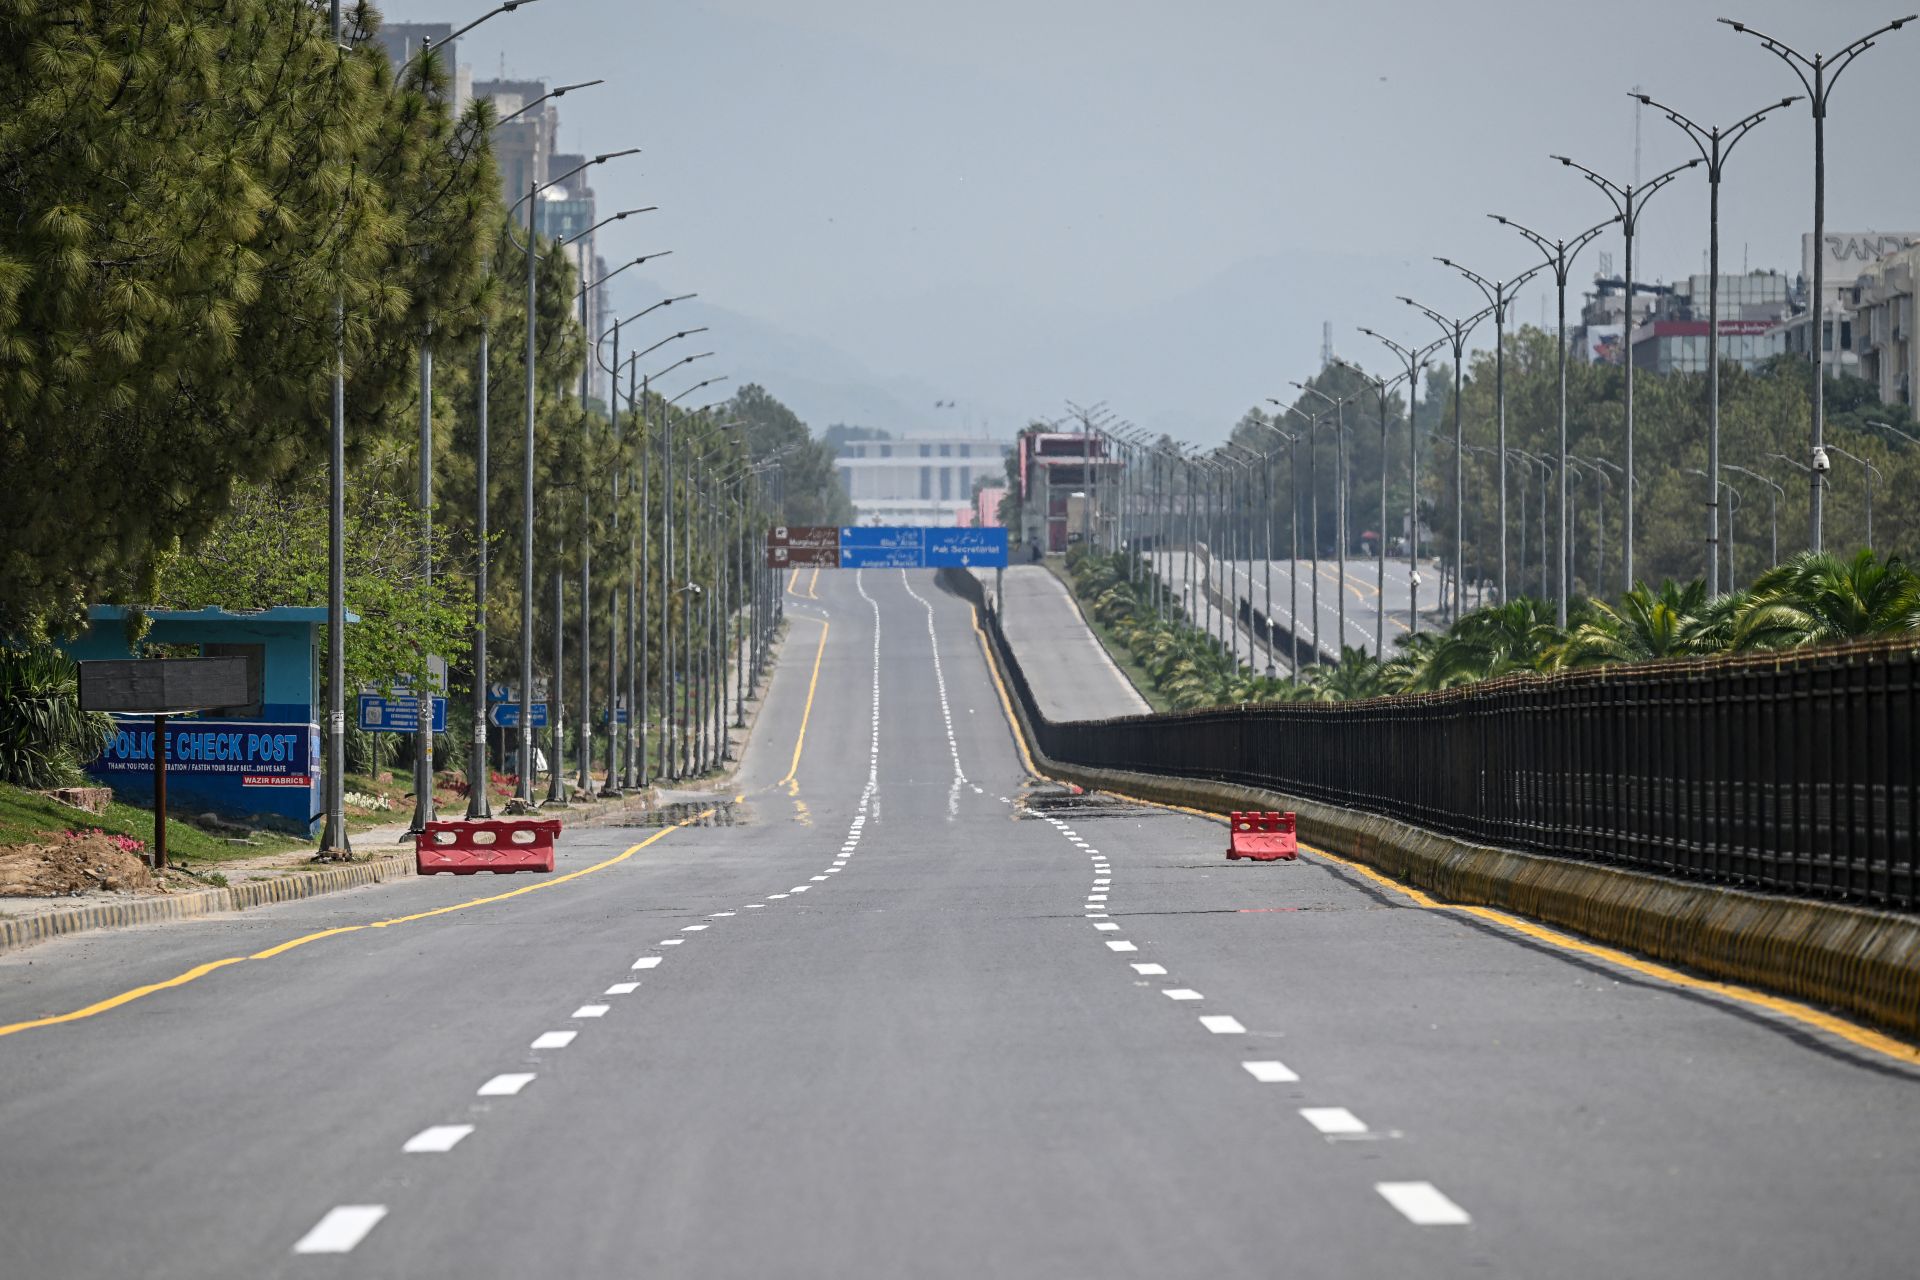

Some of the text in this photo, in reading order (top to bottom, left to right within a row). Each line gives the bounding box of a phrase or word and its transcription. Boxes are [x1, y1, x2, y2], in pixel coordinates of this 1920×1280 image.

[103, 730, 172, 760] POLICE
[177, 732, 243, 761] CHECK
[248, 734, 297, 762] POST
[108, 762, 126, 770] THANK
[127, 762, 137, 770] YOU
[192, 763, 211, 771] FASTEN
[227, 764, 239, 772] SEAT
